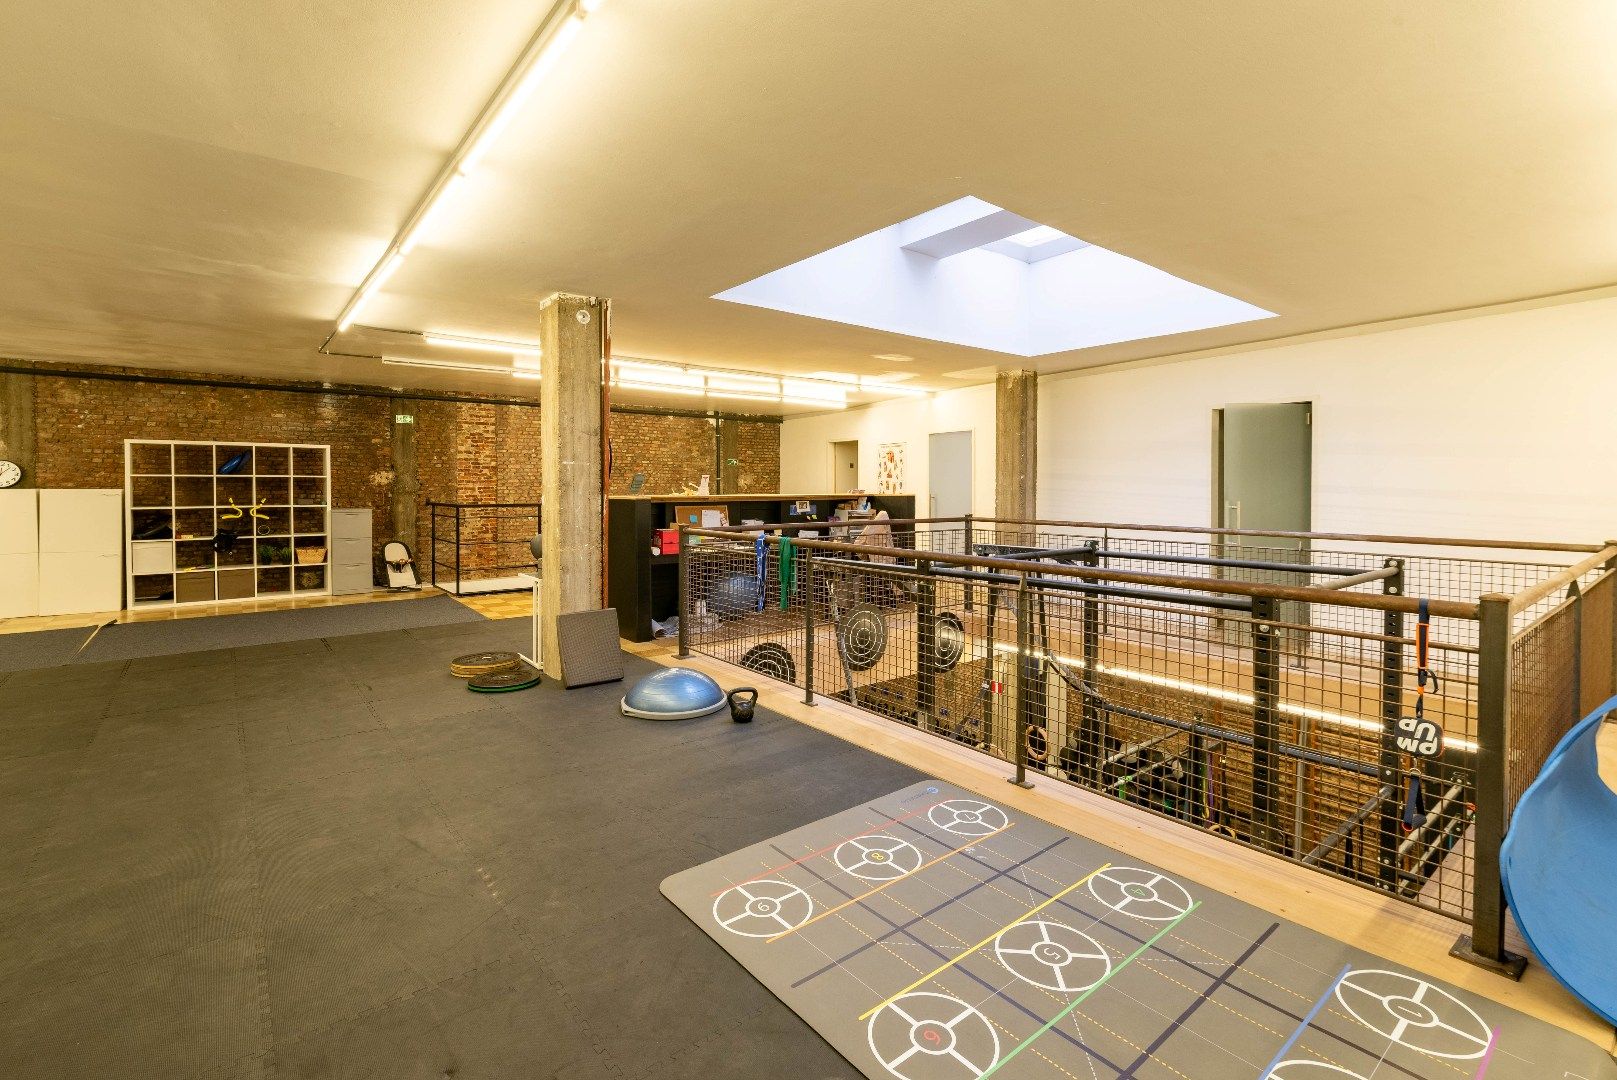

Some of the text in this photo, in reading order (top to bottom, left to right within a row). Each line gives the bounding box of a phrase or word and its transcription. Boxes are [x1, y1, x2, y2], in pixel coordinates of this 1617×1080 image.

[964, 813, 976, 821] 7
[871, 852, 884, 861] 8
[1130, 888, 1146, 897] 4
[1043, 947, 1061, 961] 5
